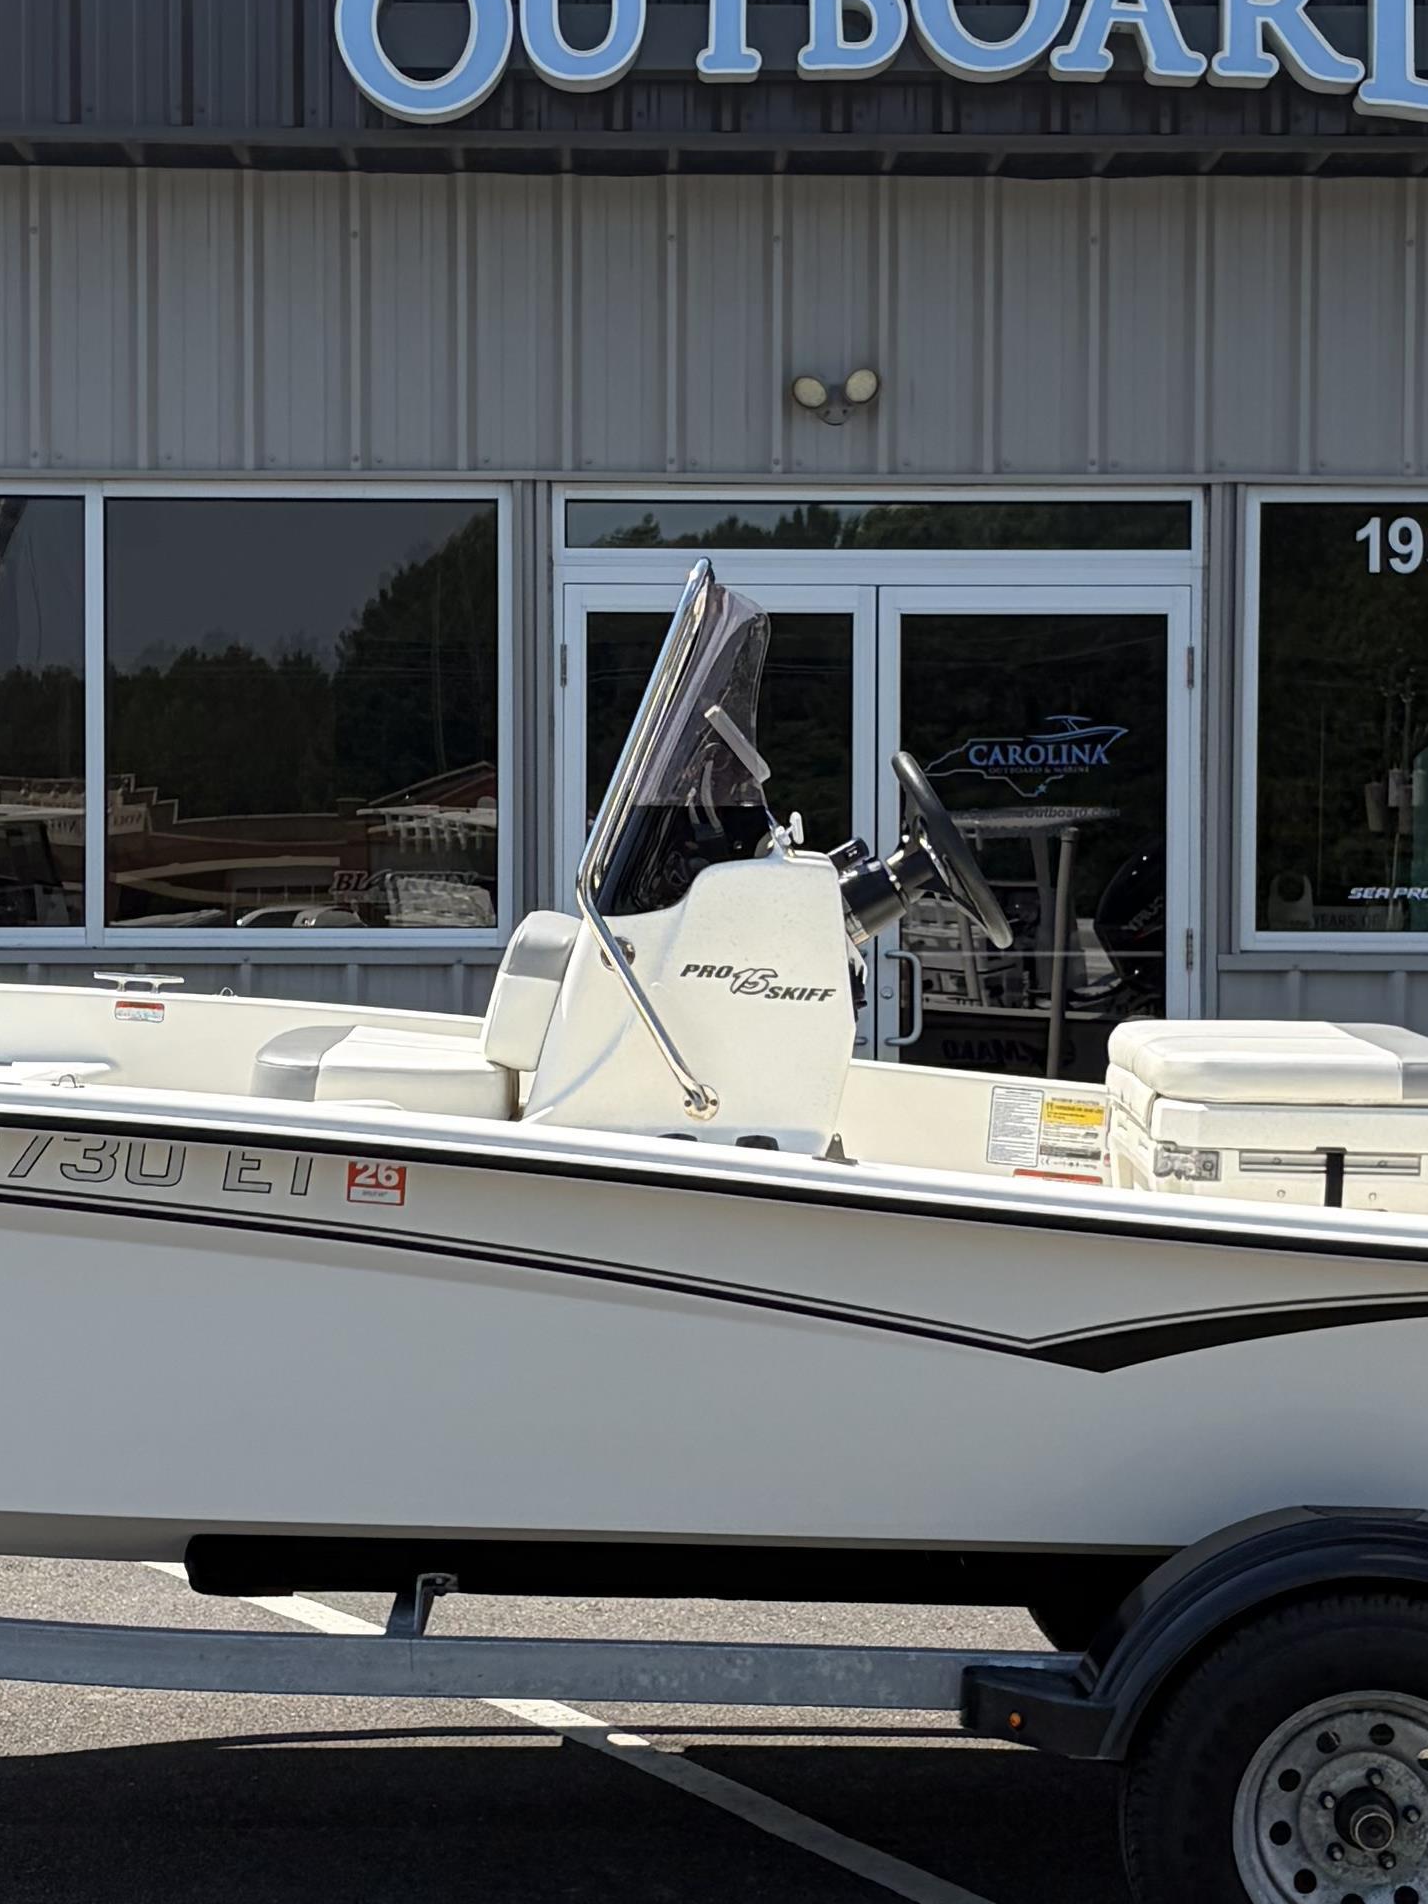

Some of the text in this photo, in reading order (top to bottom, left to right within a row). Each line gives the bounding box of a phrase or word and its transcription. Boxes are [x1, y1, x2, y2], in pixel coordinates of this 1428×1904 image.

[968, 744, 1109, 765] CAROLINA
[1348, 887, 1390, 899] SEA
[680, 963, 837, 1002] PRO 15 SKIFF
[354, 1161, 400, 1188] 26
